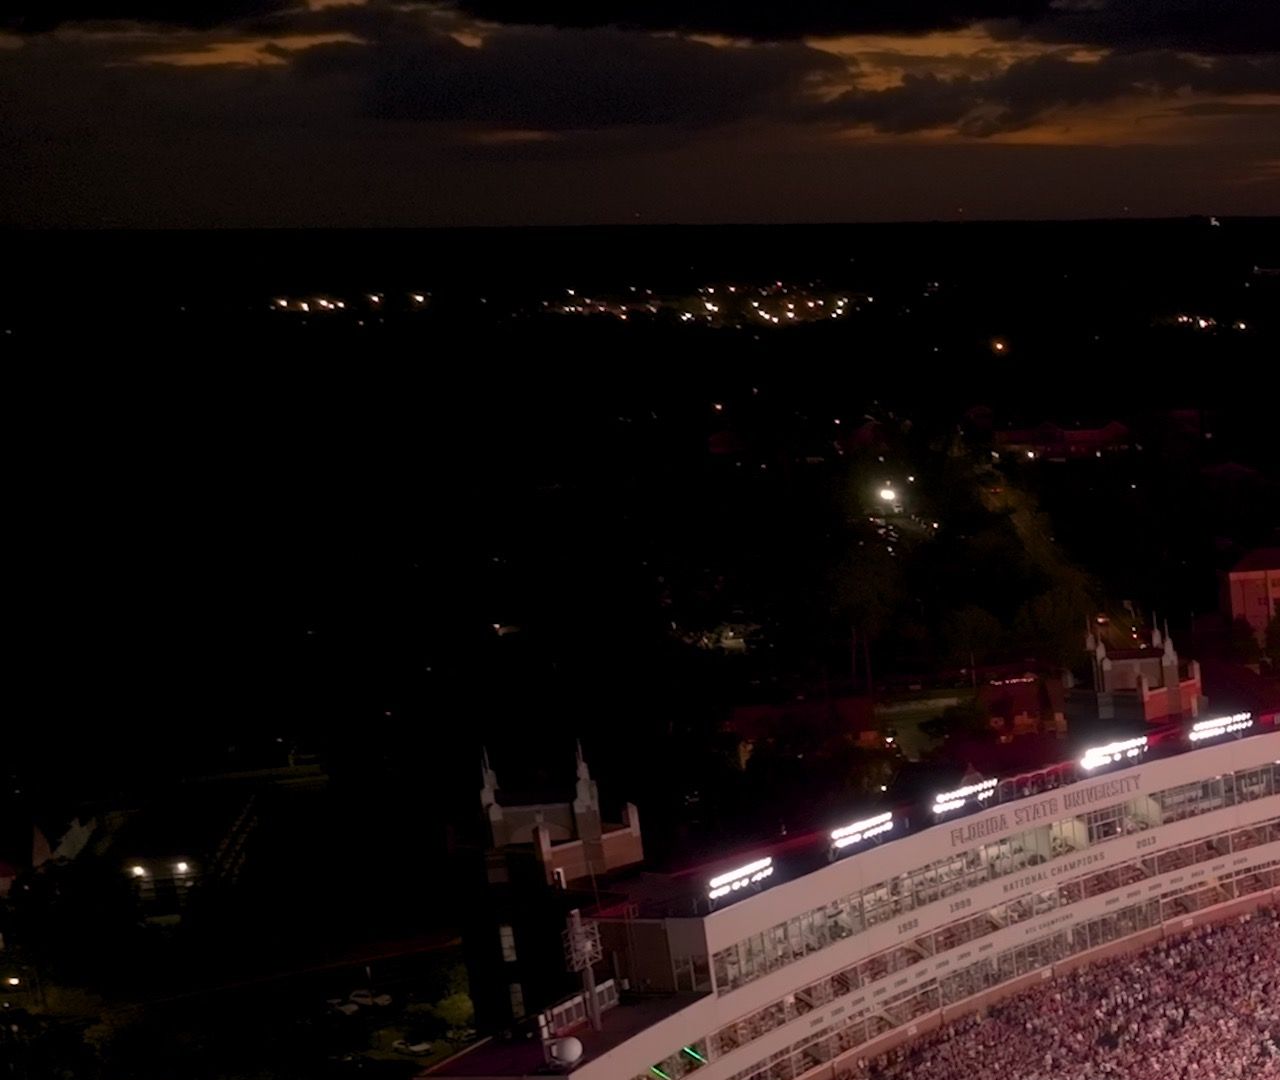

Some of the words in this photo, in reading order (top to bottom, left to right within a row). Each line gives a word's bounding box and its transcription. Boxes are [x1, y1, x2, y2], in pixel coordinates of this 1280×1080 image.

[950, 815, 1009, 847] FLORIDA
[1013, 797, 1058, 826] STATE
[1063, 774, 1142, 811] UNIVERSITY
[1002, 871, 1048, 893] NATIONAL
[1050, 851, 1105, 877] CHAMPIONS
